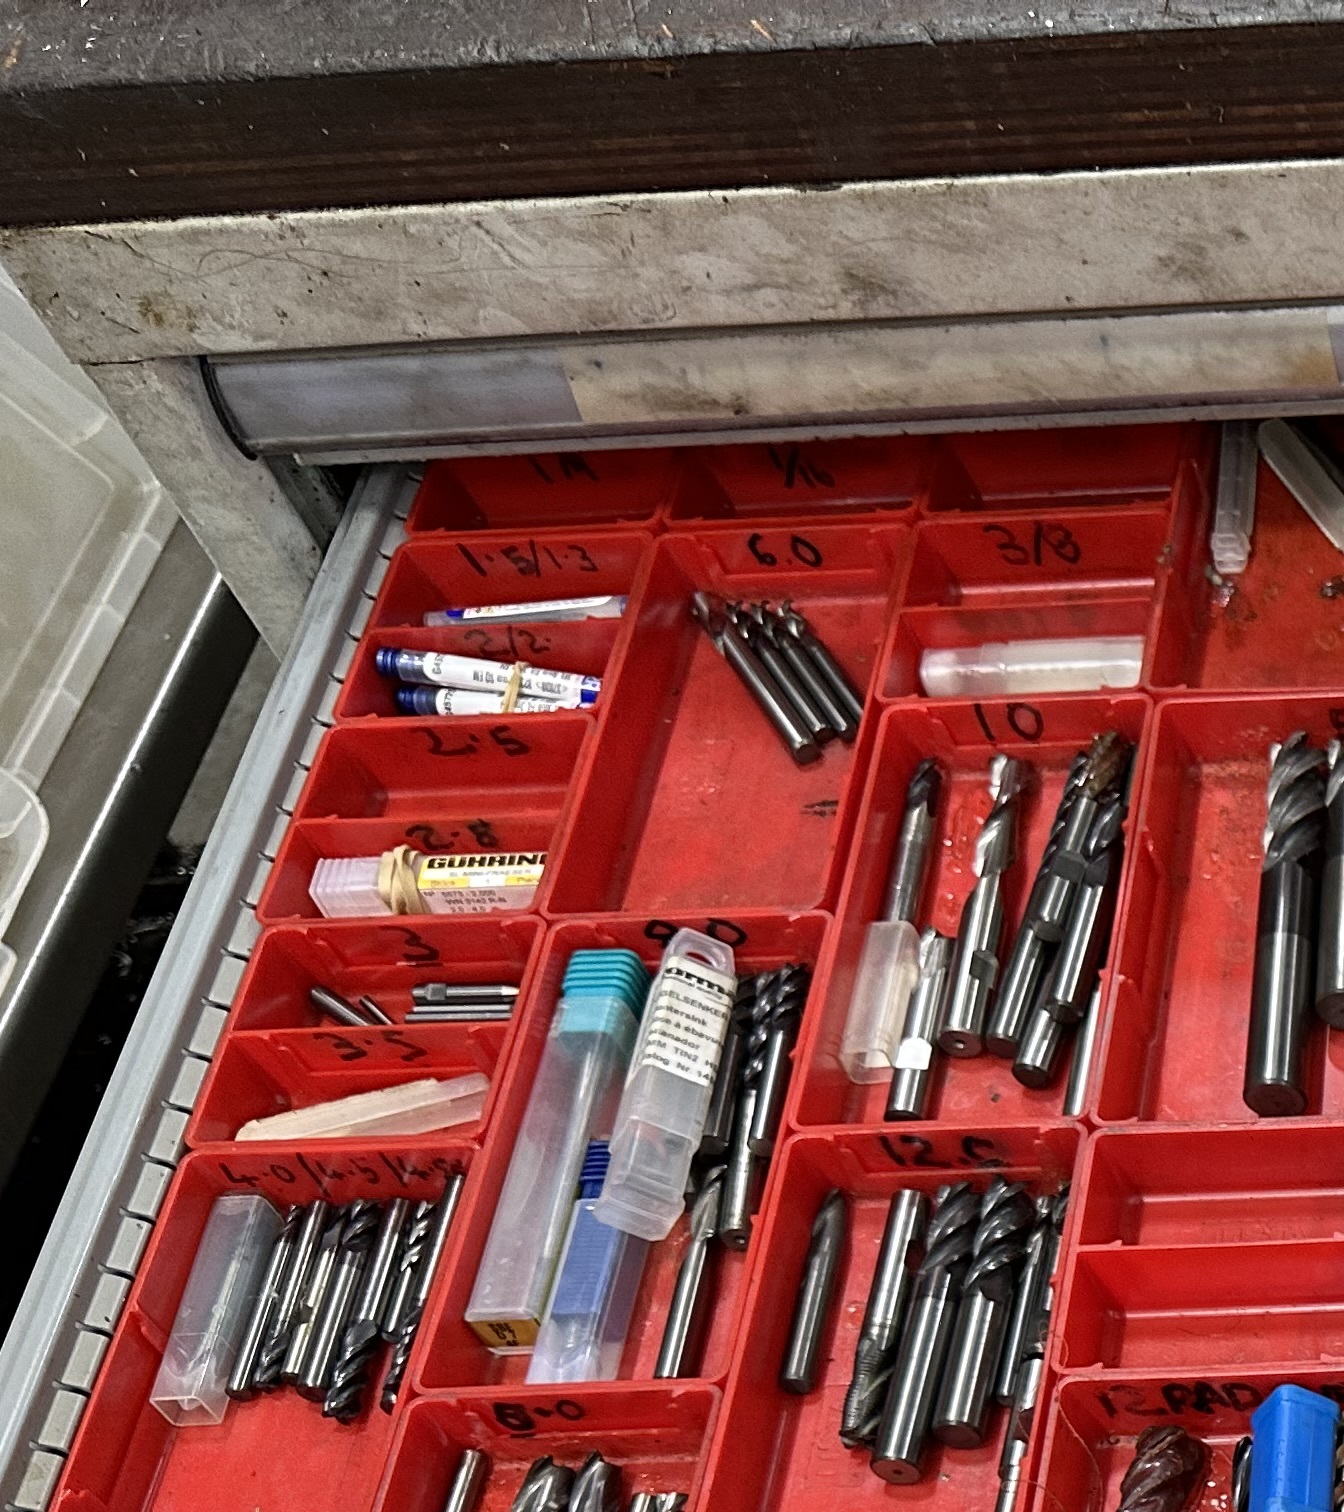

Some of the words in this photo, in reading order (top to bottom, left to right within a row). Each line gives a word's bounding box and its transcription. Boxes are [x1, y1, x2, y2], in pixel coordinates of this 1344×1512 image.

[747, 533, 823, 568] 6.0
[973, 703, 1044, 741] 10
[386, 926, 441, 966] 3
